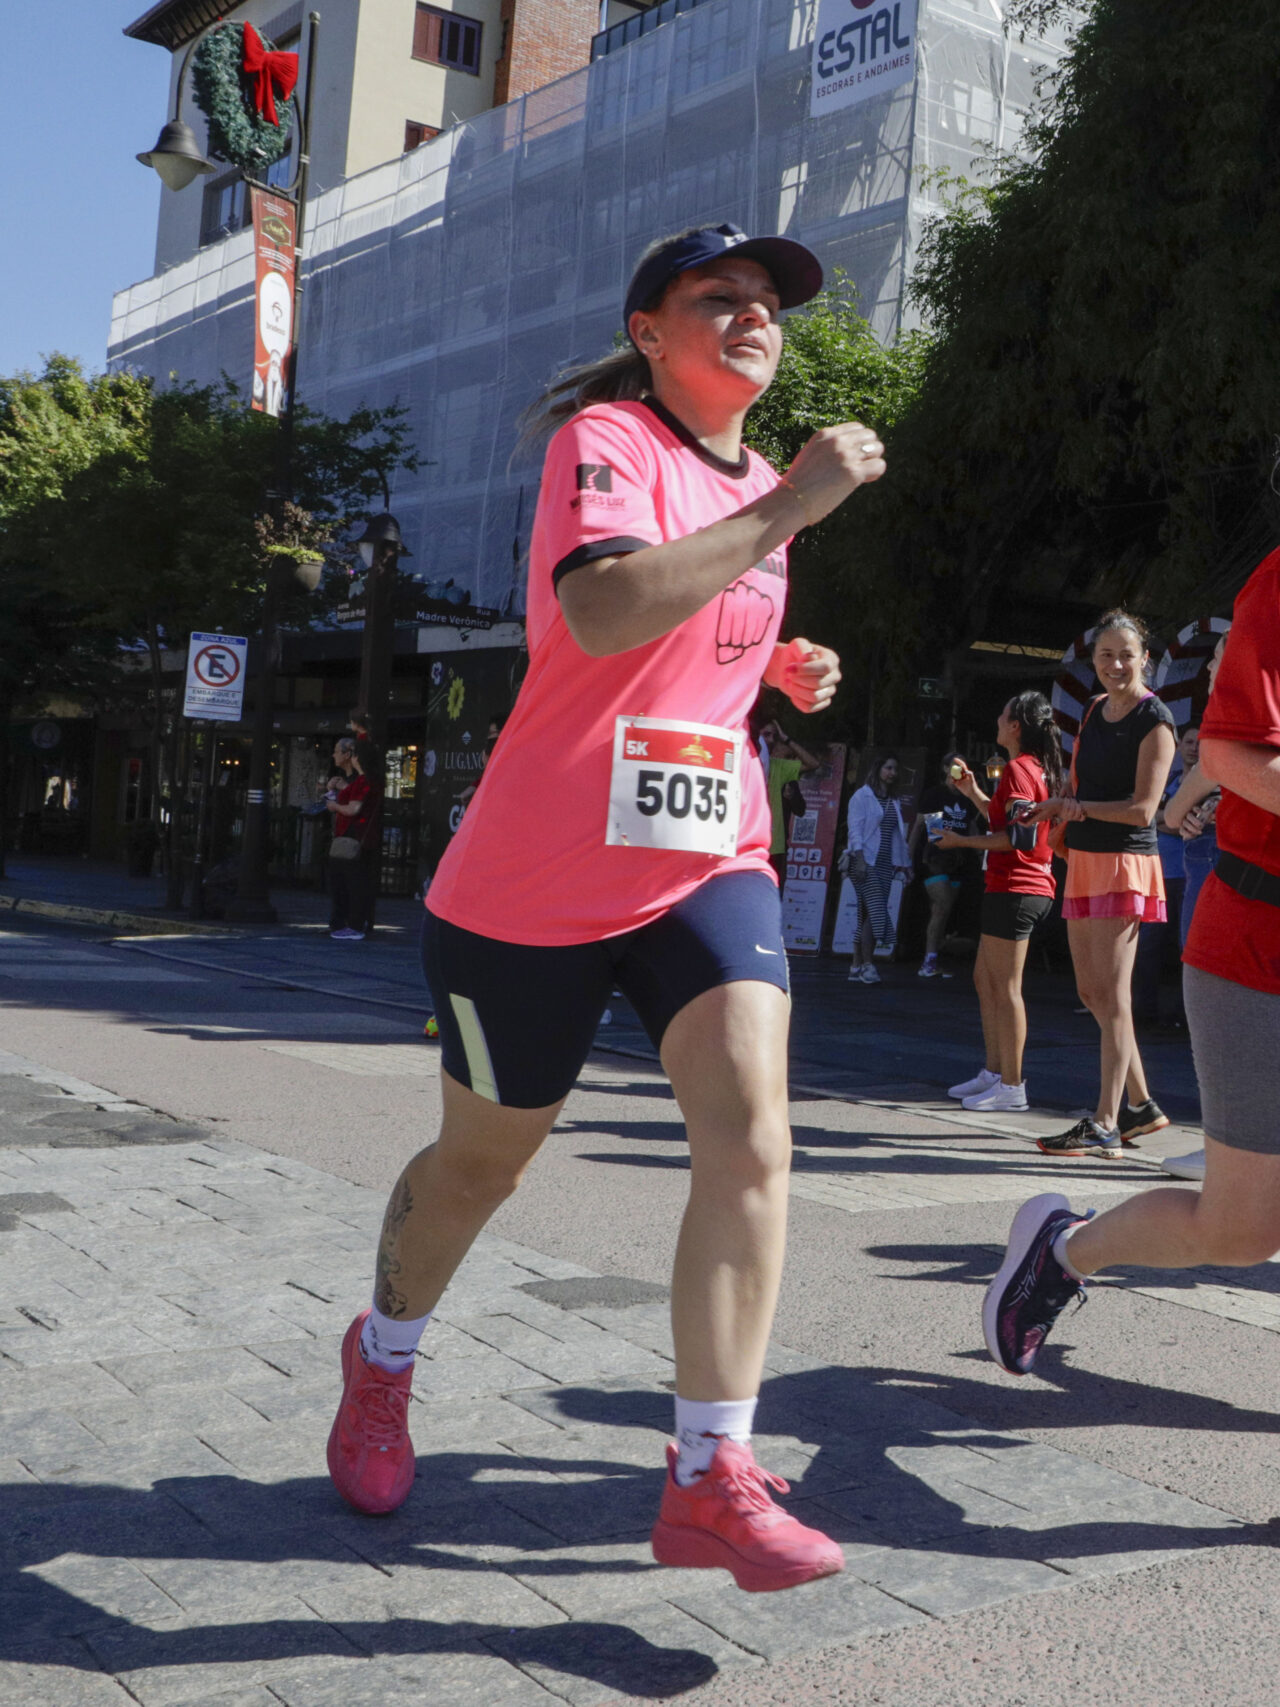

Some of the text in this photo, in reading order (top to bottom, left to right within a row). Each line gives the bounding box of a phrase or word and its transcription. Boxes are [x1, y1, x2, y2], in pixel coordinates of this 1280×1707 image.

[817, 2, 911, 79] ESTAL
[816, 53, 911, 99] ESCORAS E ANDAIMES
[415, 610, 491, 629] Madre Verônica
[475, 608, 491, 617] Rua
[187, 695, 239, 706] DESEMBARQUE
[192, 688, 230, 698] EMBARQUE
[625, 740, 649, 757] 5K
[635, 768, 729, 824] 5035
[943, 820, 967, 829] adidas
